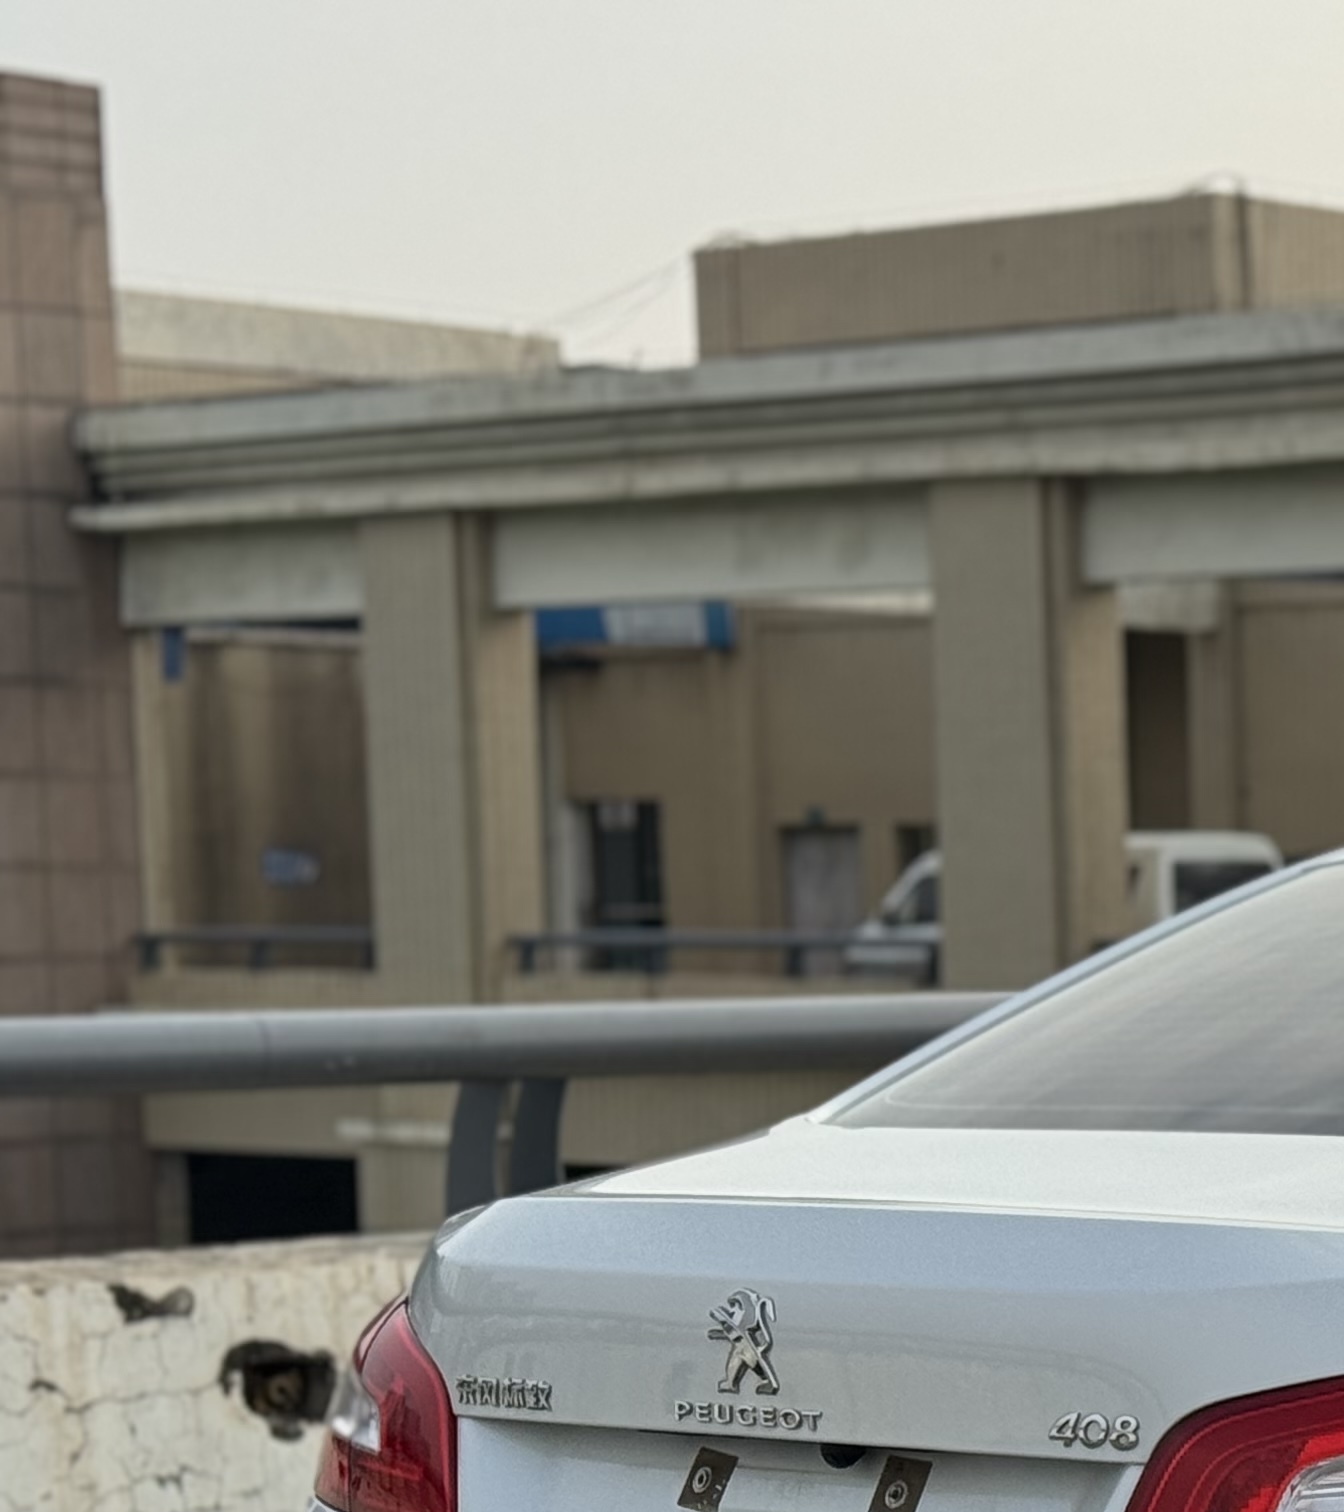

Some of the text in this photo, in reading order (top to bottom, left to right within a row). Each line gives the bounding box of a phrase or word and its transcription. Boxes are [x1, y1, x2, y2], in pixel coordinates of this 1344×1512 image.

[456, 1374, 553, 1412] 东风标致
[674, 1400, 823, 1432] PEUGEOT
[1048, 1410, 1140, 1451] 408
